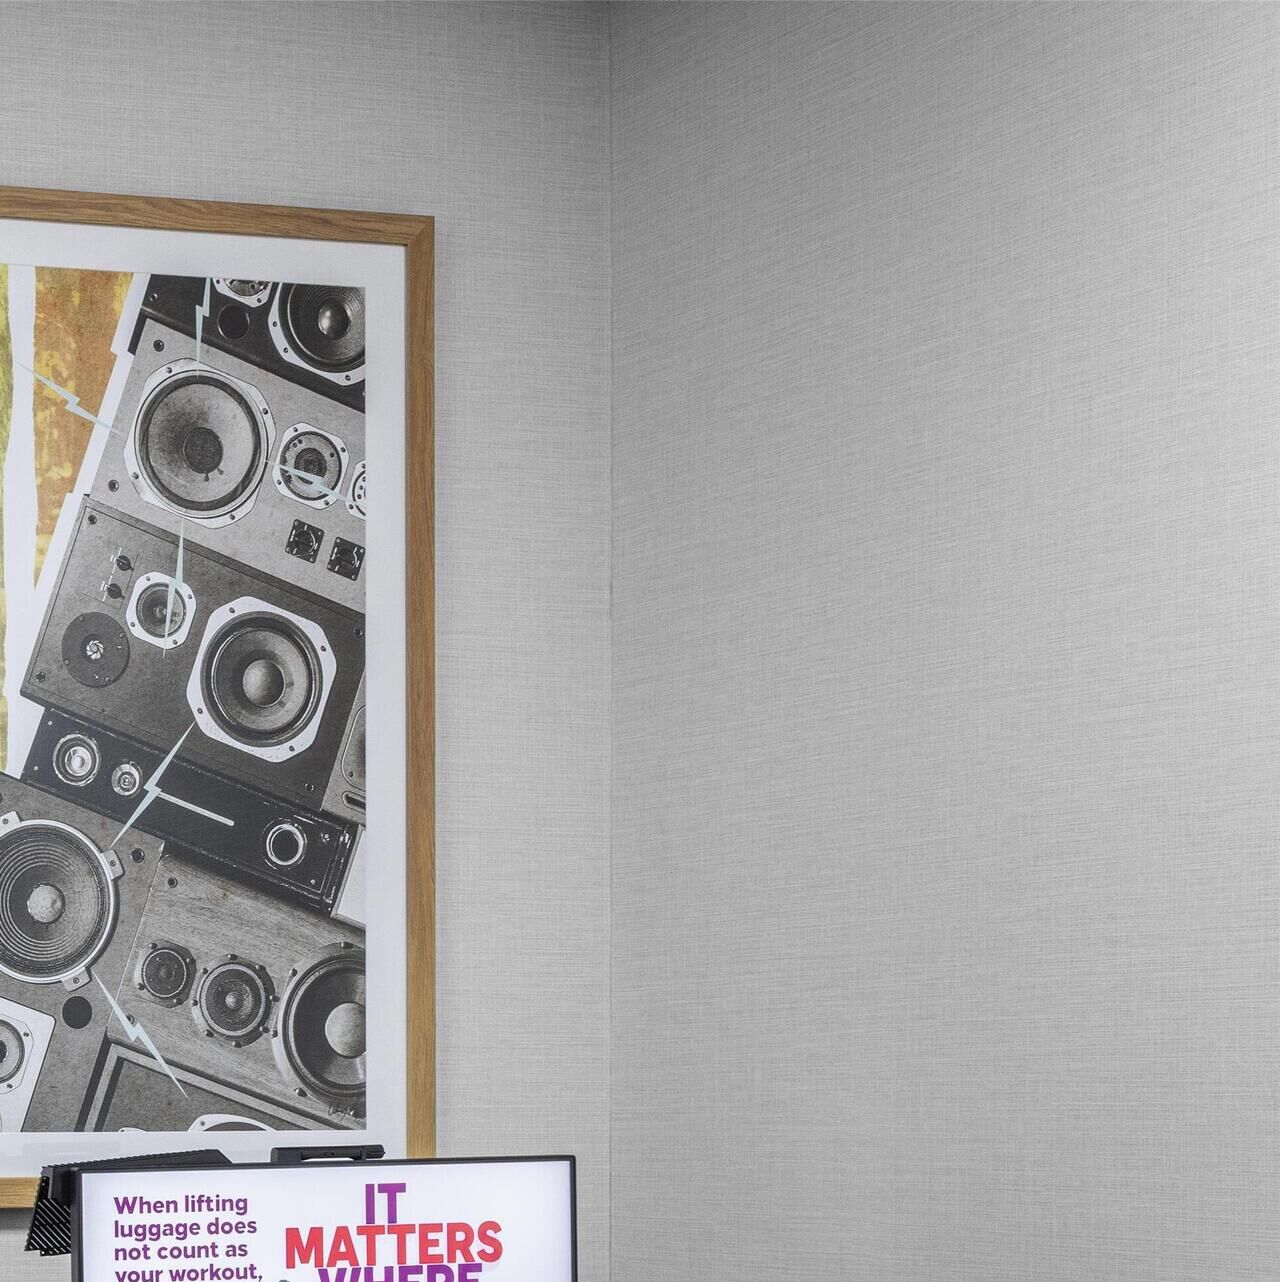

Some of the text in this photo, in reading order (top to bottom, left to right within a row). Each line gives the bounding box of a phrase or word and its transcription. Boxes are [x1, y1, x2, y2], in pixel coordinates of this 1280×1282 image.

[113, 1194, 248, 1216] When lifting
[365, 1182, 406, 1224] IT
[114, 1217, 257, 1242] luggage does
[114, 1242, 248, 1261] not count as
[285, 1221, 503, 1269] MATTERS
[169, 1263, 263, 1282] workout,
